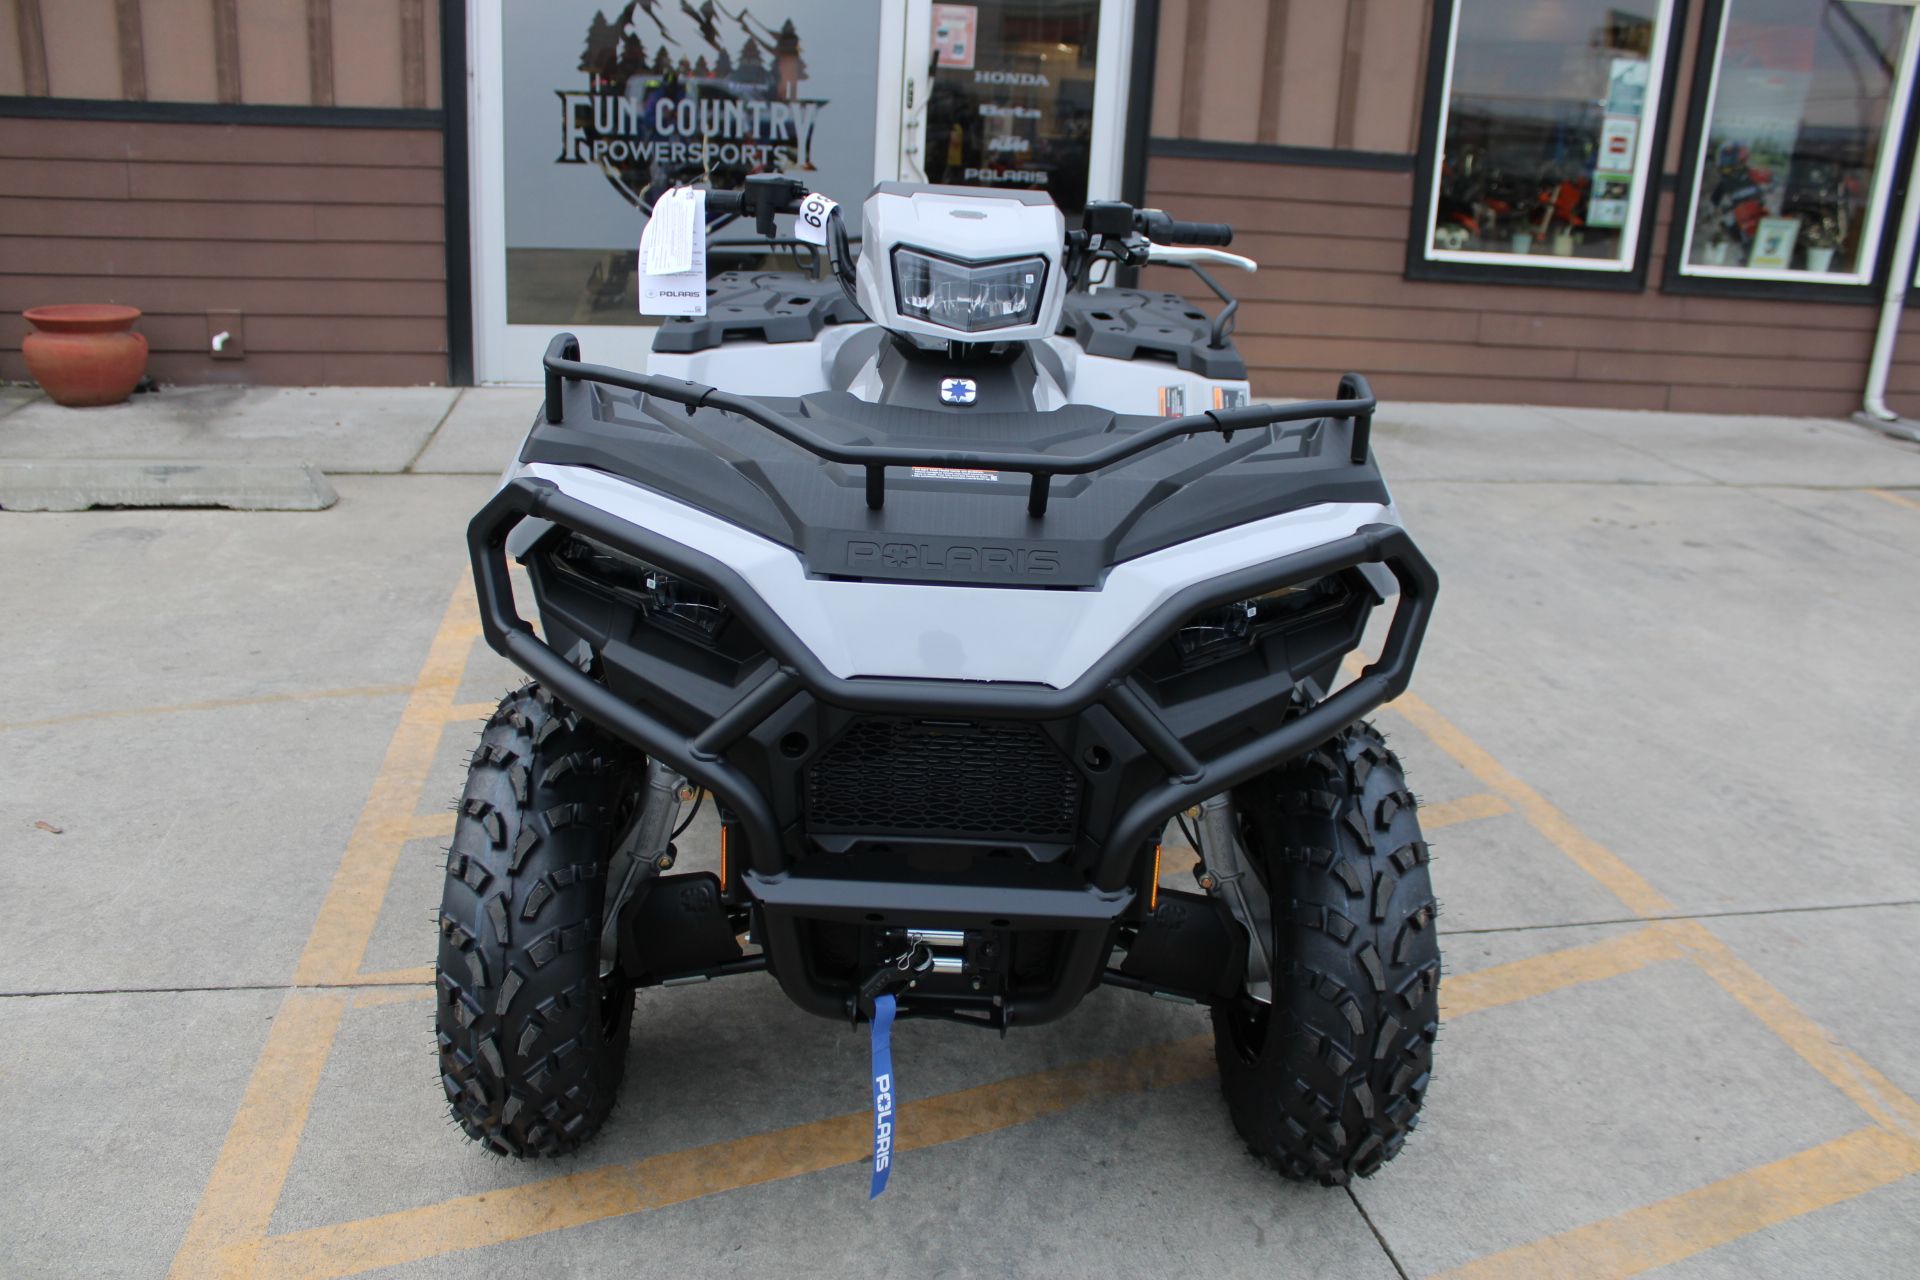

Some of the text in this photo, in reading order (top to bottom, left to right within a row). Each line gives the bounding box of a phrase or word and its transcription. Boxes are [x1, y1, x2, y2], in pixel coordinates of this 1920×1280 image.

[974, 70, 1049, 87] HONDA
[979, 104, 1042, 119] Beta
[558, 92, 824, 169] FUN COUNTRY
[988, 135, 1029, 152] KTM
[593, 139, 788, 166] POWERSPORTS
[964, 168, 1049, 184] POLARIS
[659, 290, 700, 298] POLARIS
[847, 540, 1061, 576] POLARIS
[875, 1073, 892, 1173] POLARIS
